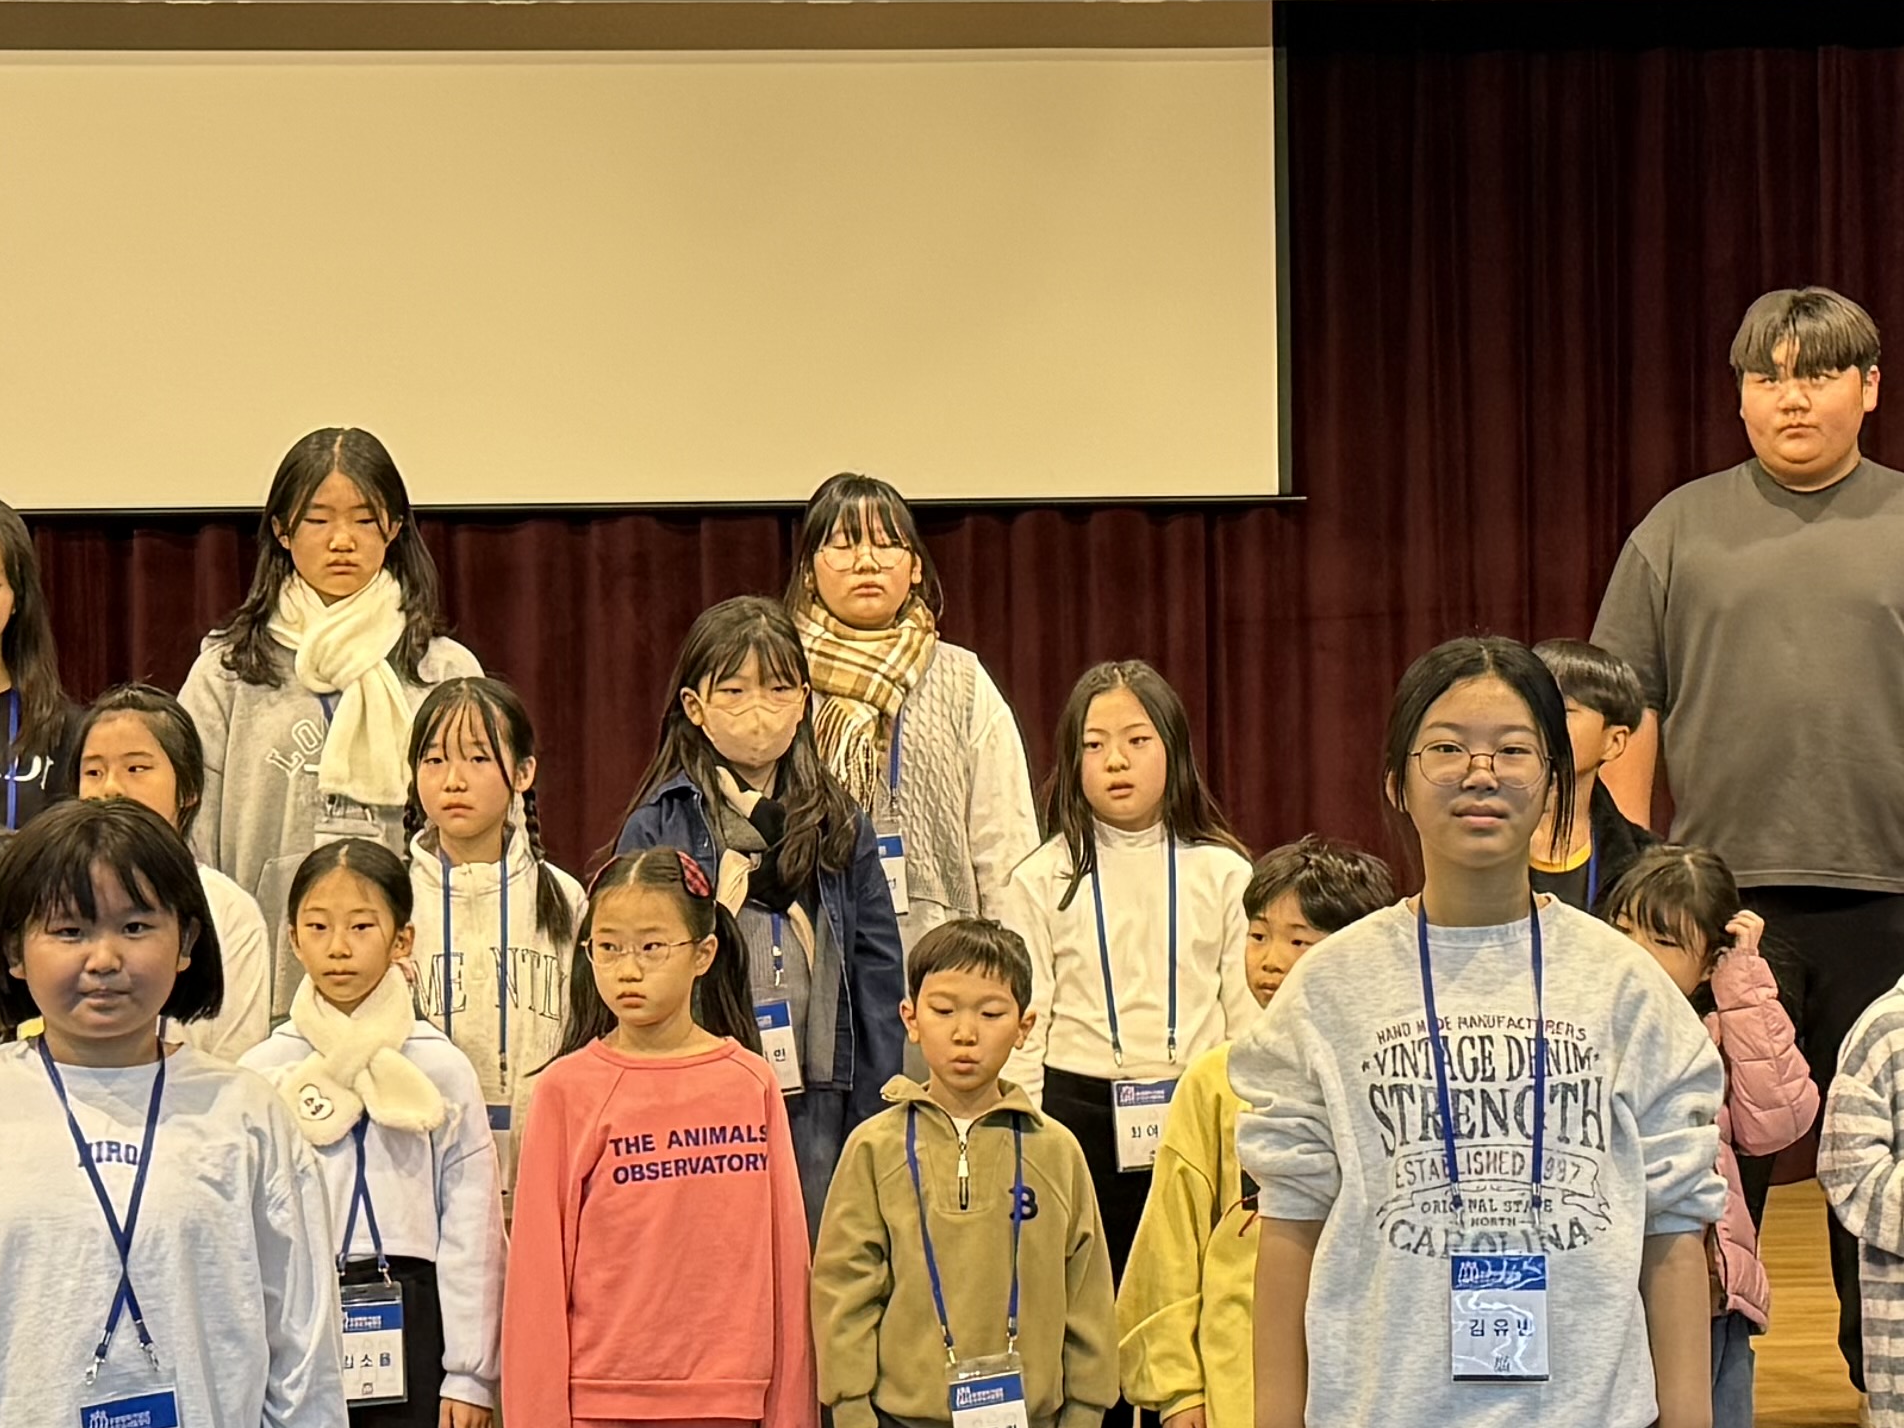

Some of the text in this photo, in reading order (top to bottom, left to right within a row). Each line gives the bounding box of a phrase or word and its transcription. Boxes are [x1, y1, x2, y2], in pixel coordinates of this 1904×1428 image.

[609, 1124, 768, 1157] THE ANIMALS
[612, 1152, 768, 1185] OBSERVATORY
[1008, 1185, 1038, 1220] B
